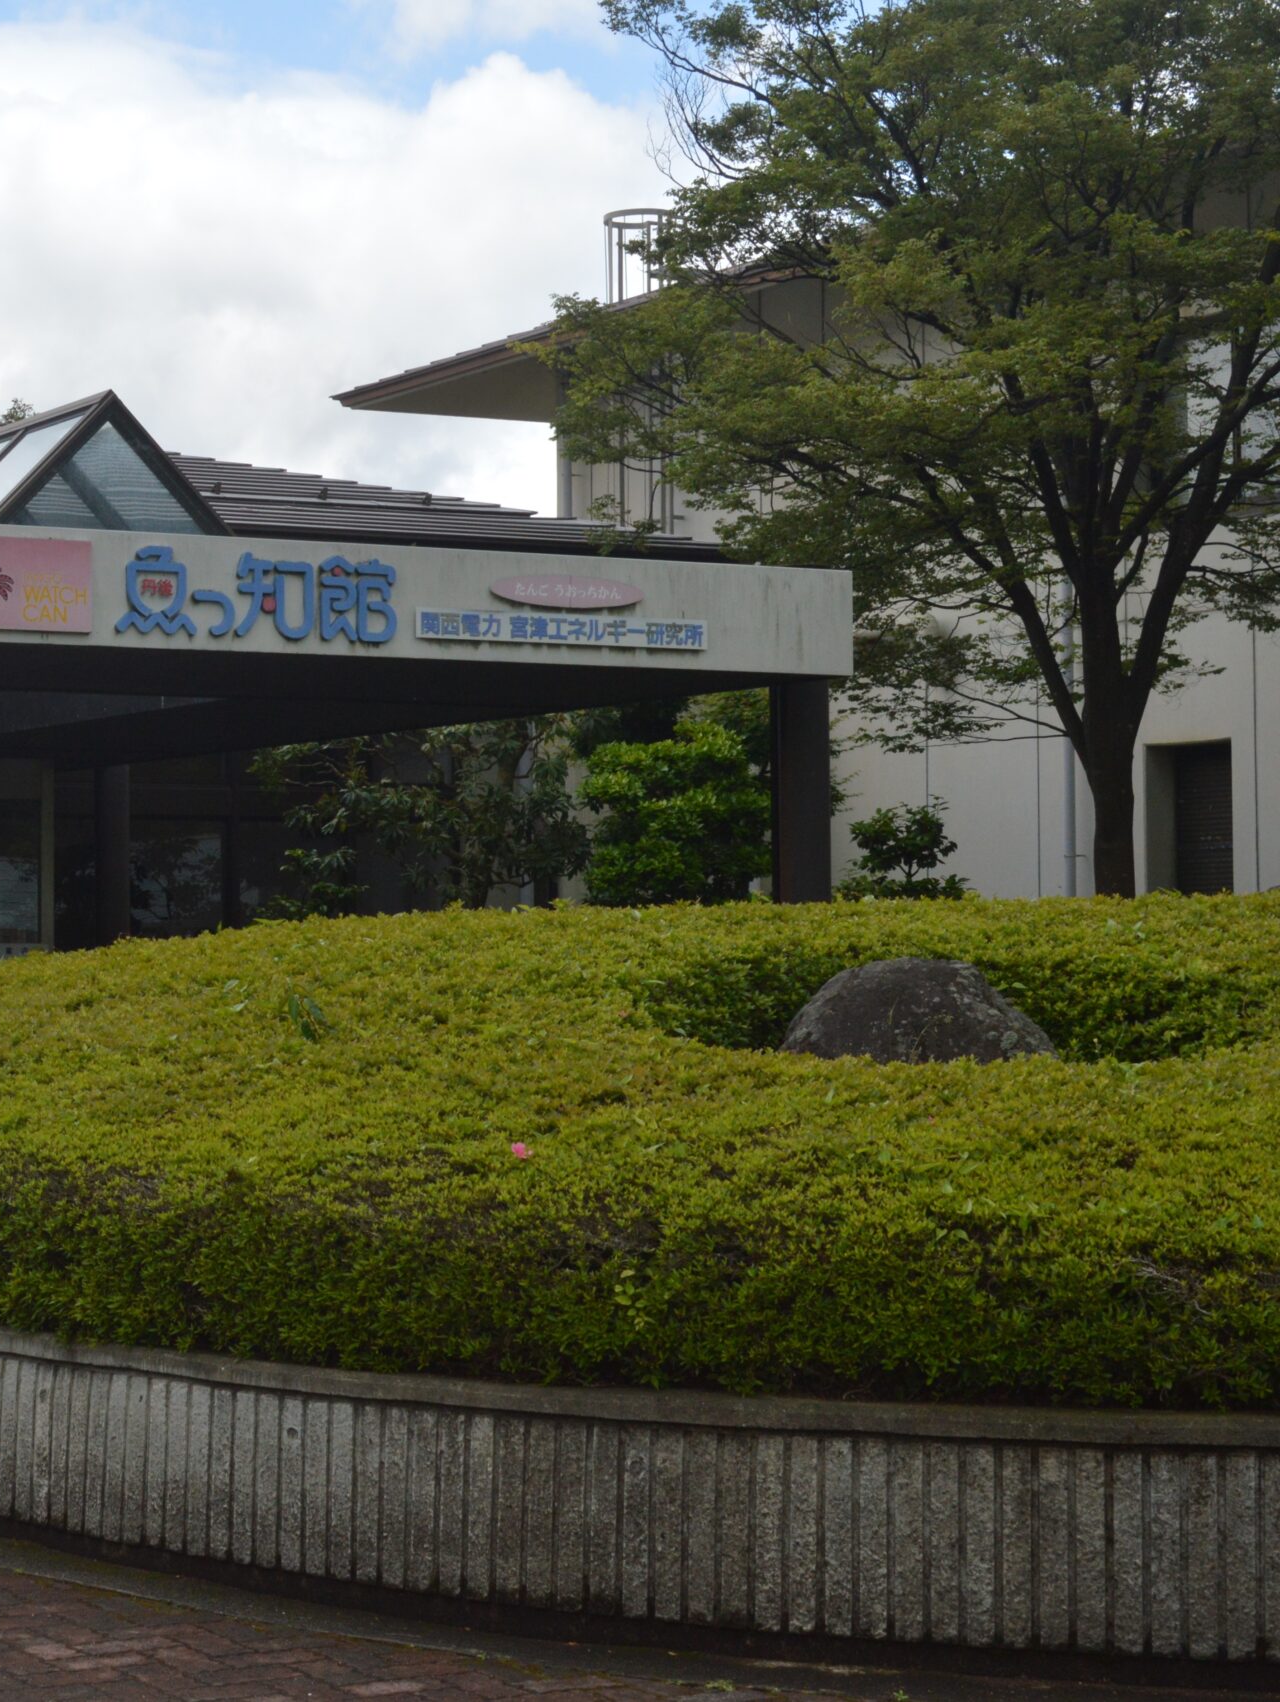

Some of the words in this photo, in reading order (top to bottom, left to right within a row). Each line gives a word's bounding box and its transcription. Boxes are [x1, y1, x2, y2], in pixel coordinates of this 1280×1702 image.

[23, 585, 89, 607] WATCH
[140, 578, 174, 597] 丹後
[514, 583, 549, 597] たんご
[554, 584, 622, 600] うおっちかん
[23, 604, 68, 624] CAN
[420, 611, 501, 638] 関西電力
[509, 616, 703, 647] 宮津エネルギー研究所
